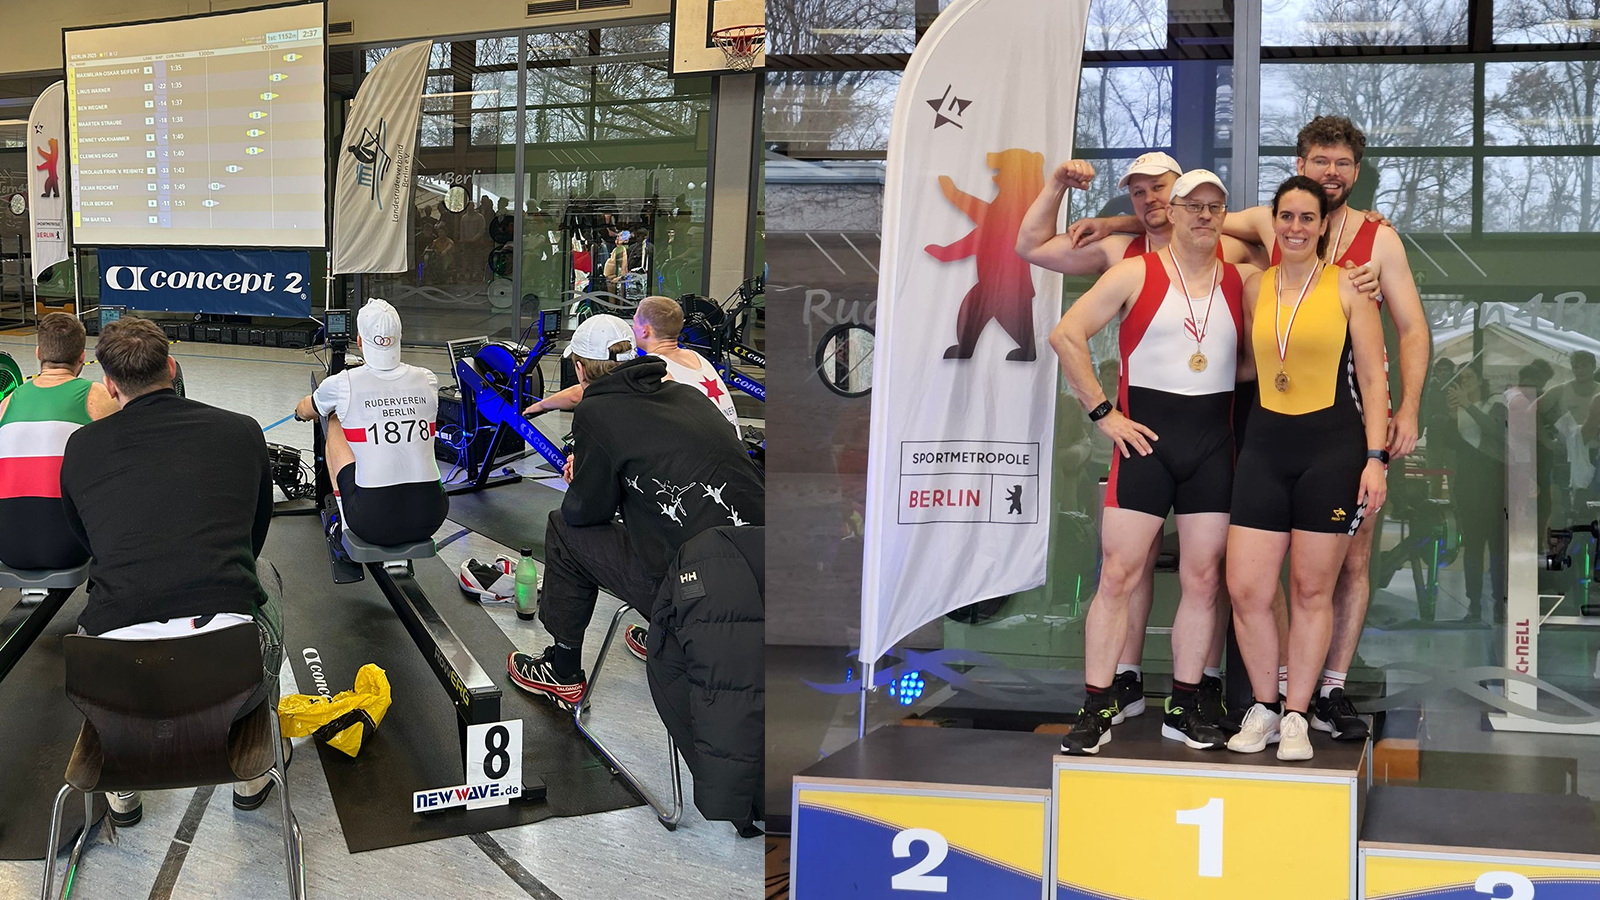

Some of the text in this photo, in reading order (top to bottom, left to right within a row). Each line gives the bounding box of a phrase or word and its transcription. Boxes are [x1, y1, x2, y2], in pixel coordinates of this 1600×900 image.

[120, 68, 140, 76] SEIFERT
[392, 144, 404, 222] Landesruderverband
[150, 270, 303, 294] concept 2
[365, 396, 427, 408] RUDERVEREIN
[382, 408, 416, 417] BERLIN
[368, 419, 430, 445] 1878
[534, 436, 564, 468] conce
[912, 452, 1030, 465] SPORTMETROPOLE
[909, 489, 980, 508] BERLIN
[680, 571, 698, 583] HH
[1516, 619, 1529, 674] CHNELL
[434, 646, 470, 706] ROWERG
[483, 725, 510, 780] 8
[1176, 798, 1224, 877] 1
[891, 828, 949, 892] 2
